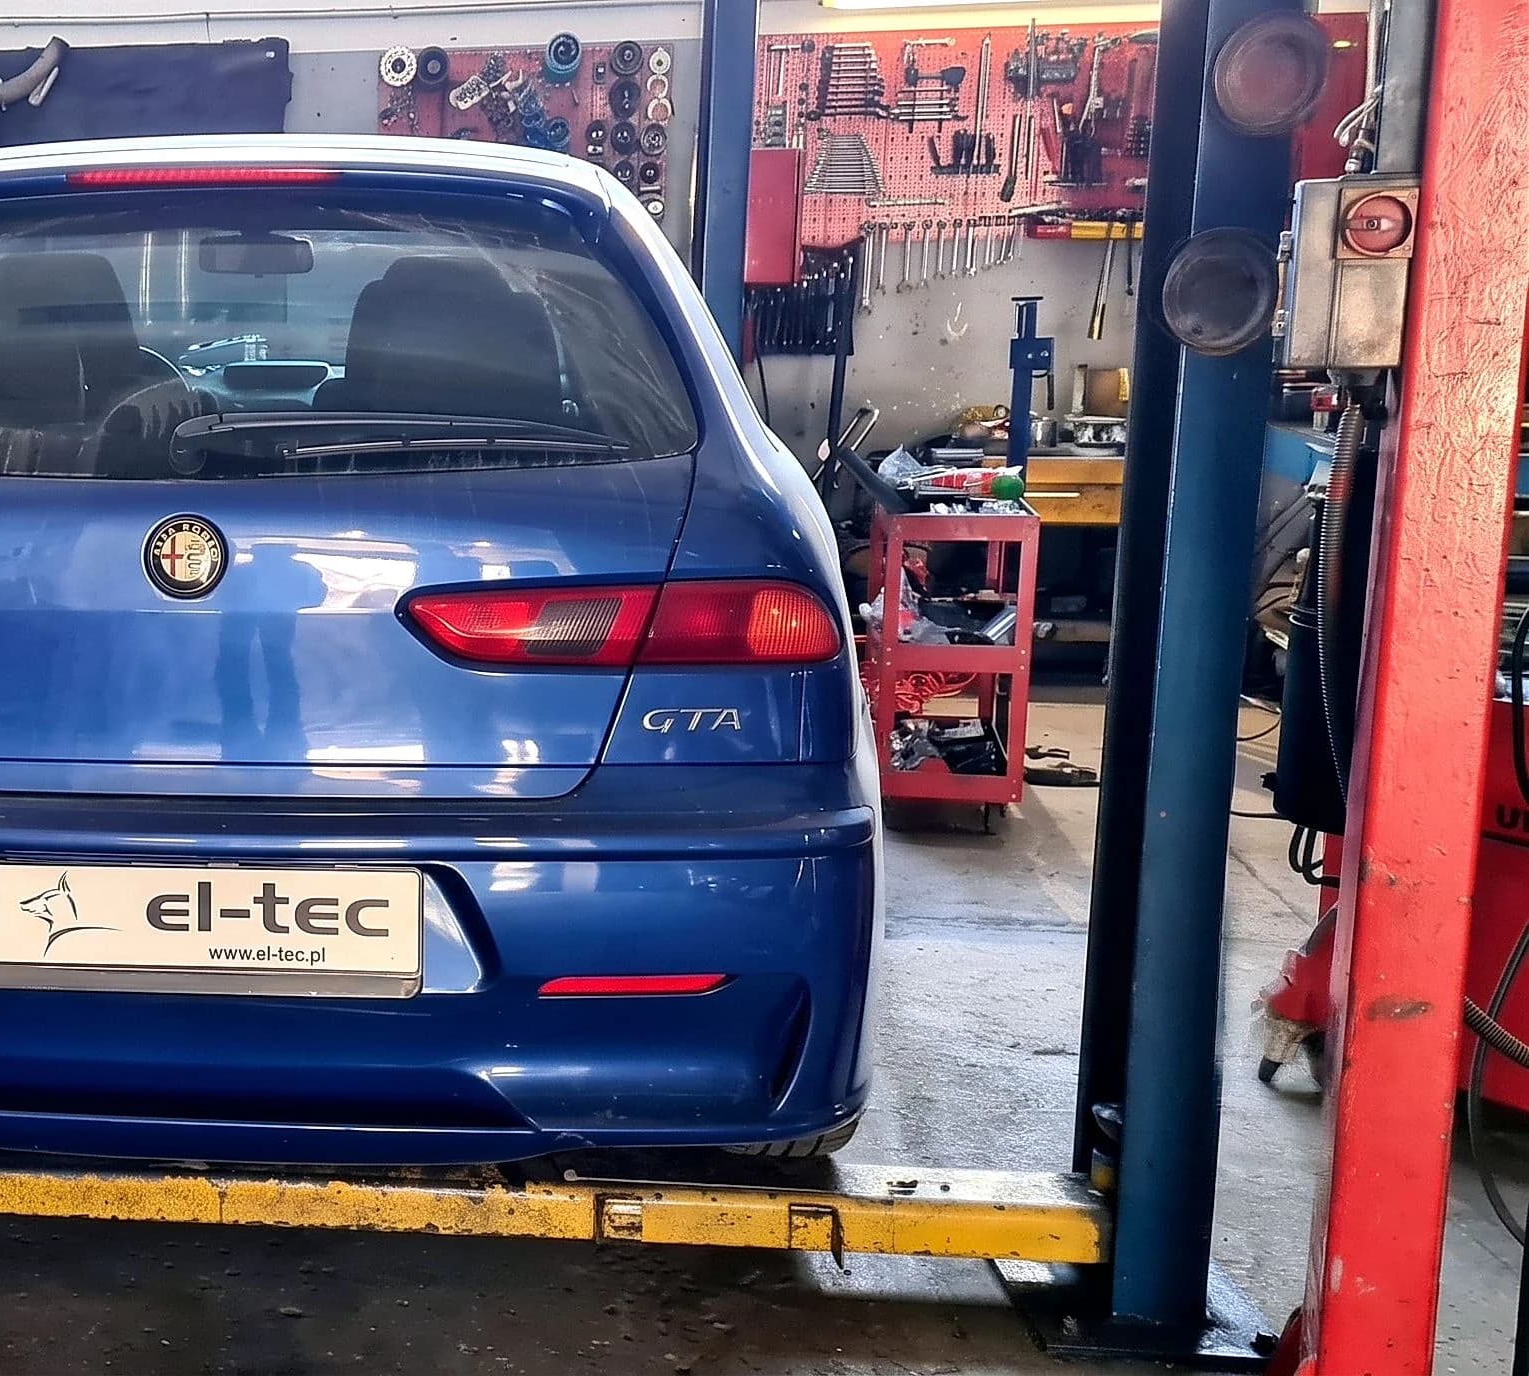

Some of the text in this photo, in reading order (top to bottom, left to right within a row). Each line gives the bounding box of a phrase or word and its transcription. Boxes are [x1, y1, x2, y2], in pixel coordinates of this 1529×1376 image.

[642, 708, 742, 734] GTA
[145, 881, 390, 938] el-tec
[208, 945, 326, 966] www.el-tec.pl
